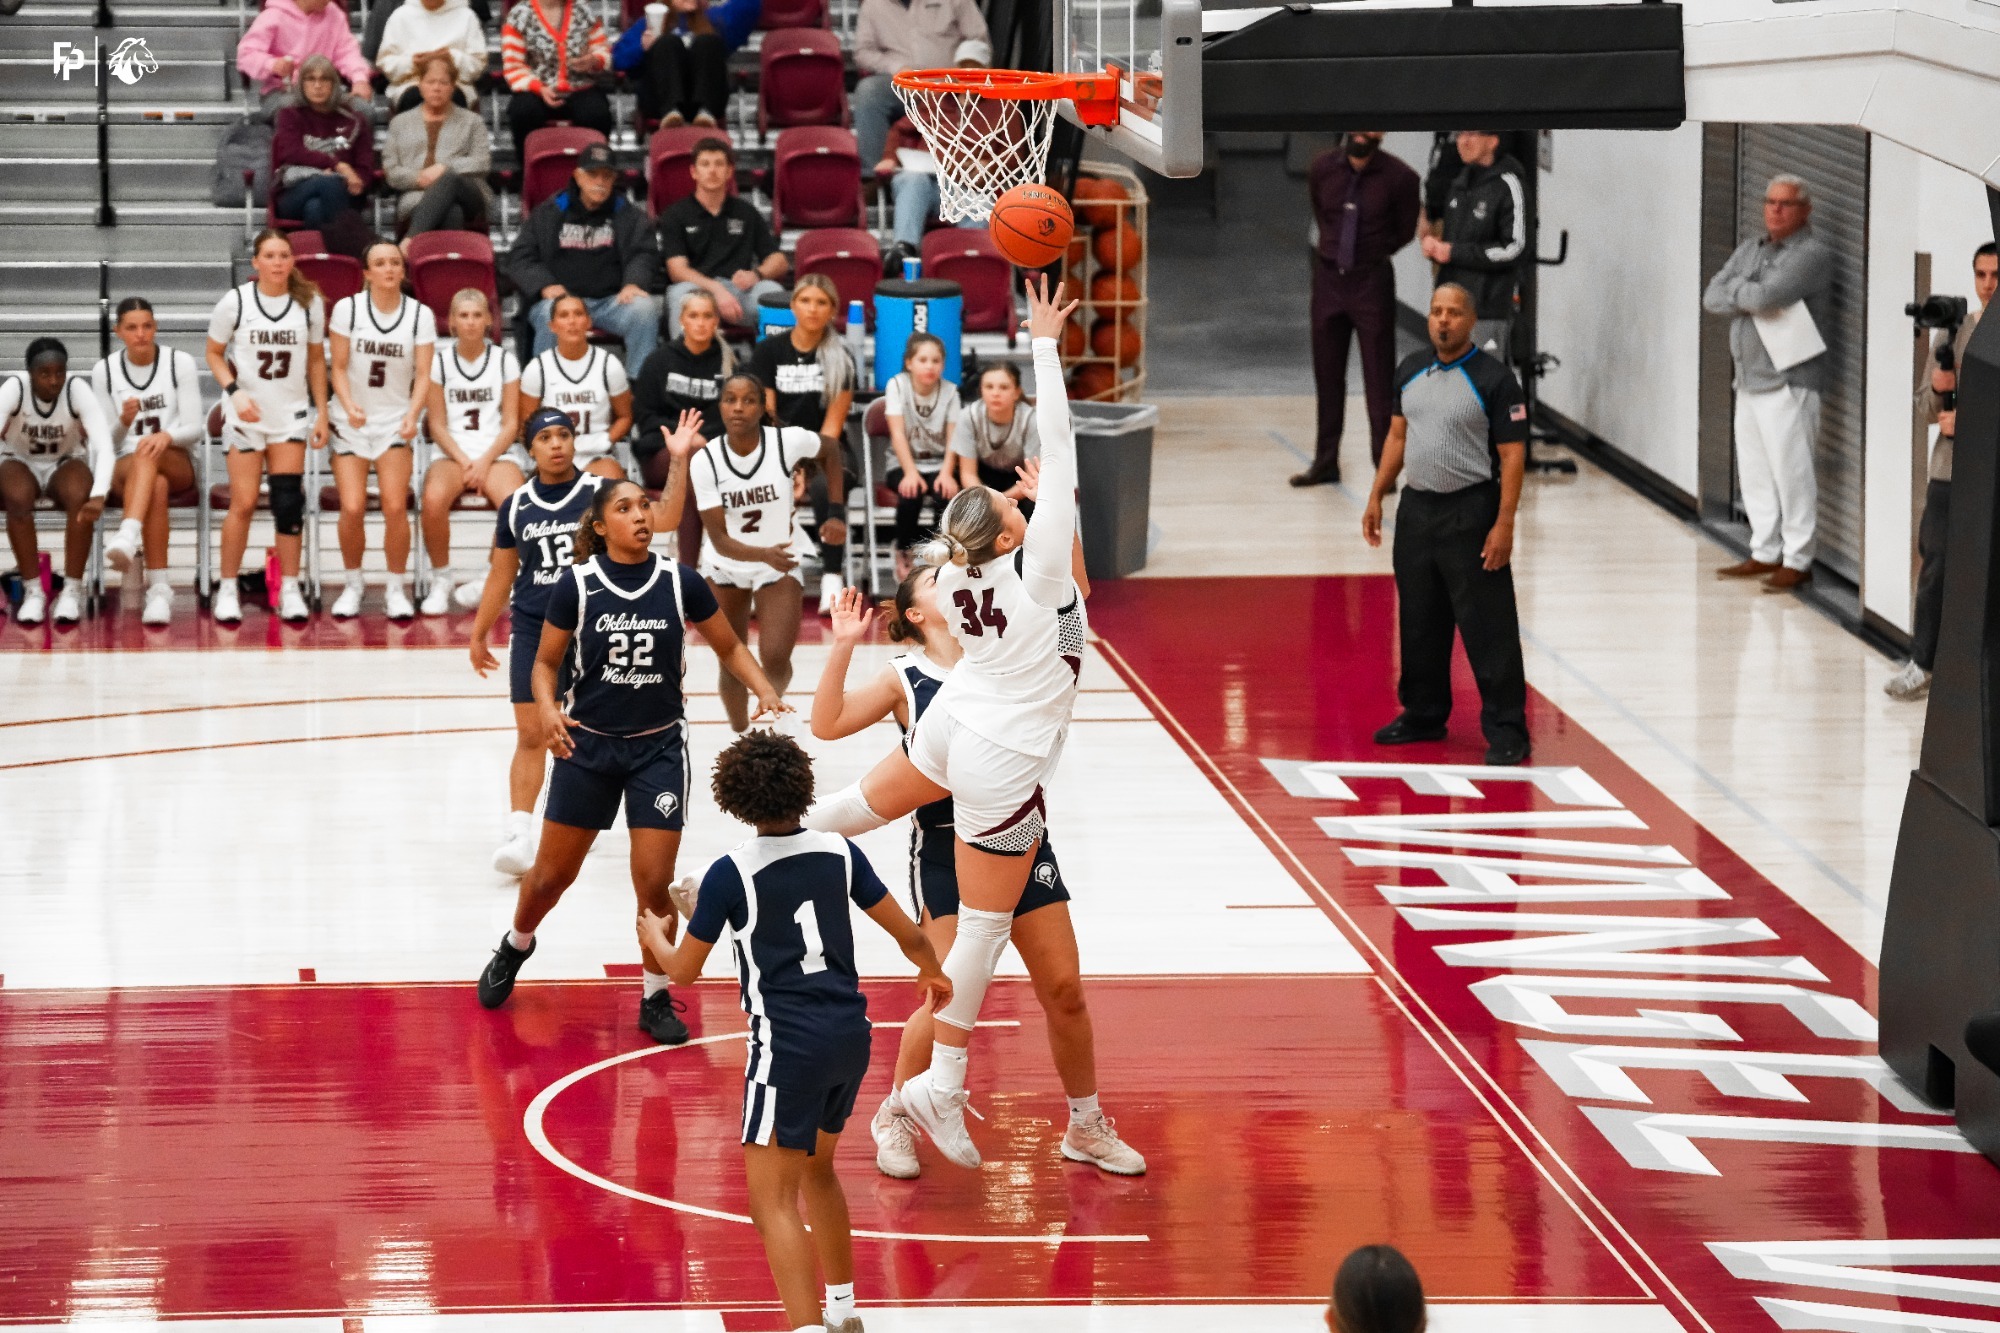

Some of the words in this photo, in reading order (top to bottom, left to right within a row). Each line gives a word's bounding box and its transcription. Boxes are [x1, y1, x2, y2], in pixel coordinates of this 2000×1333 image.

[250, 329, 298, 346] EVANGEL
[356, 338, 405, 358] EVANGEL
[257, 350, 292, 380] 23
[368, 360, 387, 388] 5
[139, 393, 168, 412] NGEL
[449, 386, 494, 403] EVANGEL
[555, 390, 598, 406] EVANGEL
[463, 408, 481, 431] 3
[721, 484, 779, 508] EVANGEL
[741, 509, 763, 533] 2
[537, 534, 574, 568] 12
[533, 566, 563, 585] Wesl
[595, 613, 668, 632] Oklahoma
[953, 587, 1008, 638] 34
[608, 632, 654, 666] 22
[600, 664, 663, 690] Wesleyan
[793, 900, 828, 975] 1
[1259, 757, 1981, 1178] EVANGEL
